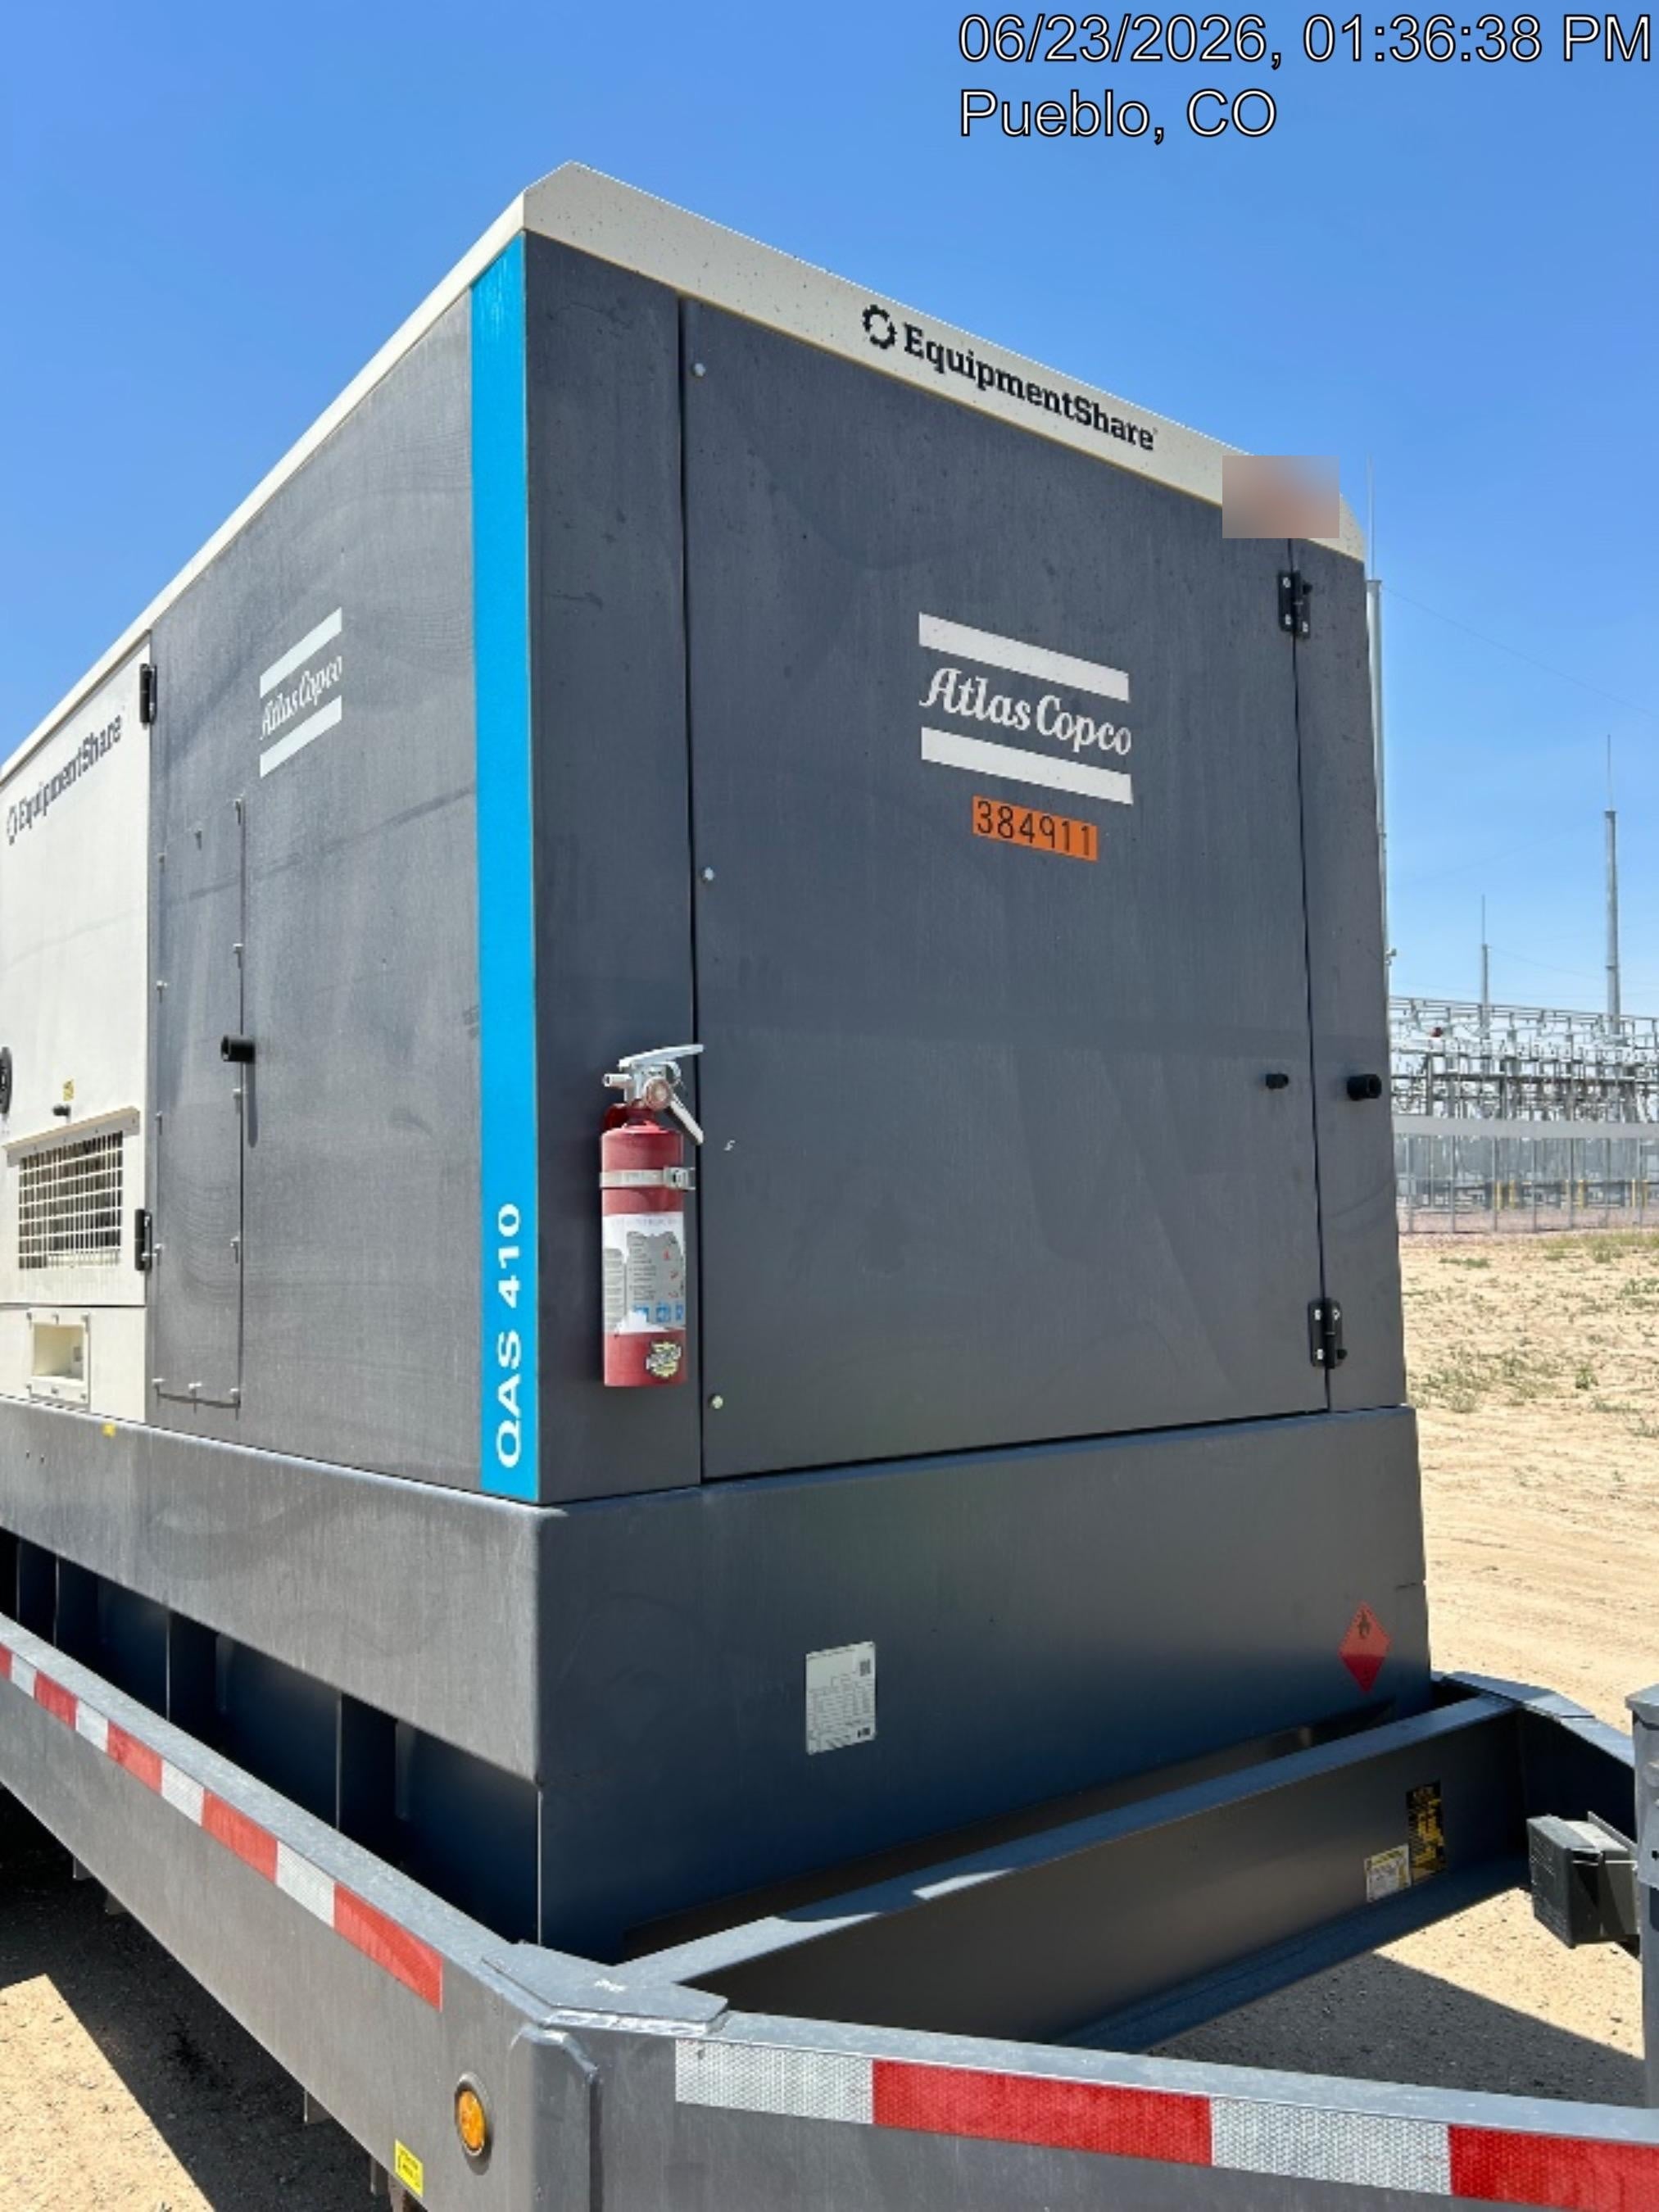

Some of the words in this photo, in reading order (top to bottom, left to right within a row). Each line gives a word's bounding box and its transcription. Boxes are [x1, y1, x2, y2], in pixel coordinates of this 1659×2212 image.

[903, 323, 1154, 451] EquipmentShare
[260, 694, 298, 741] Atlas
[299, 656, 342, 705] Copco
[919, 668, 1031, 731] Atlas
[1036, 695, 1131, 755] Copco
[977, 800, 1090, 856] 384911
[498, 1203, 520, 1308] 410
[496, 1330, 521, 1468] QAS
